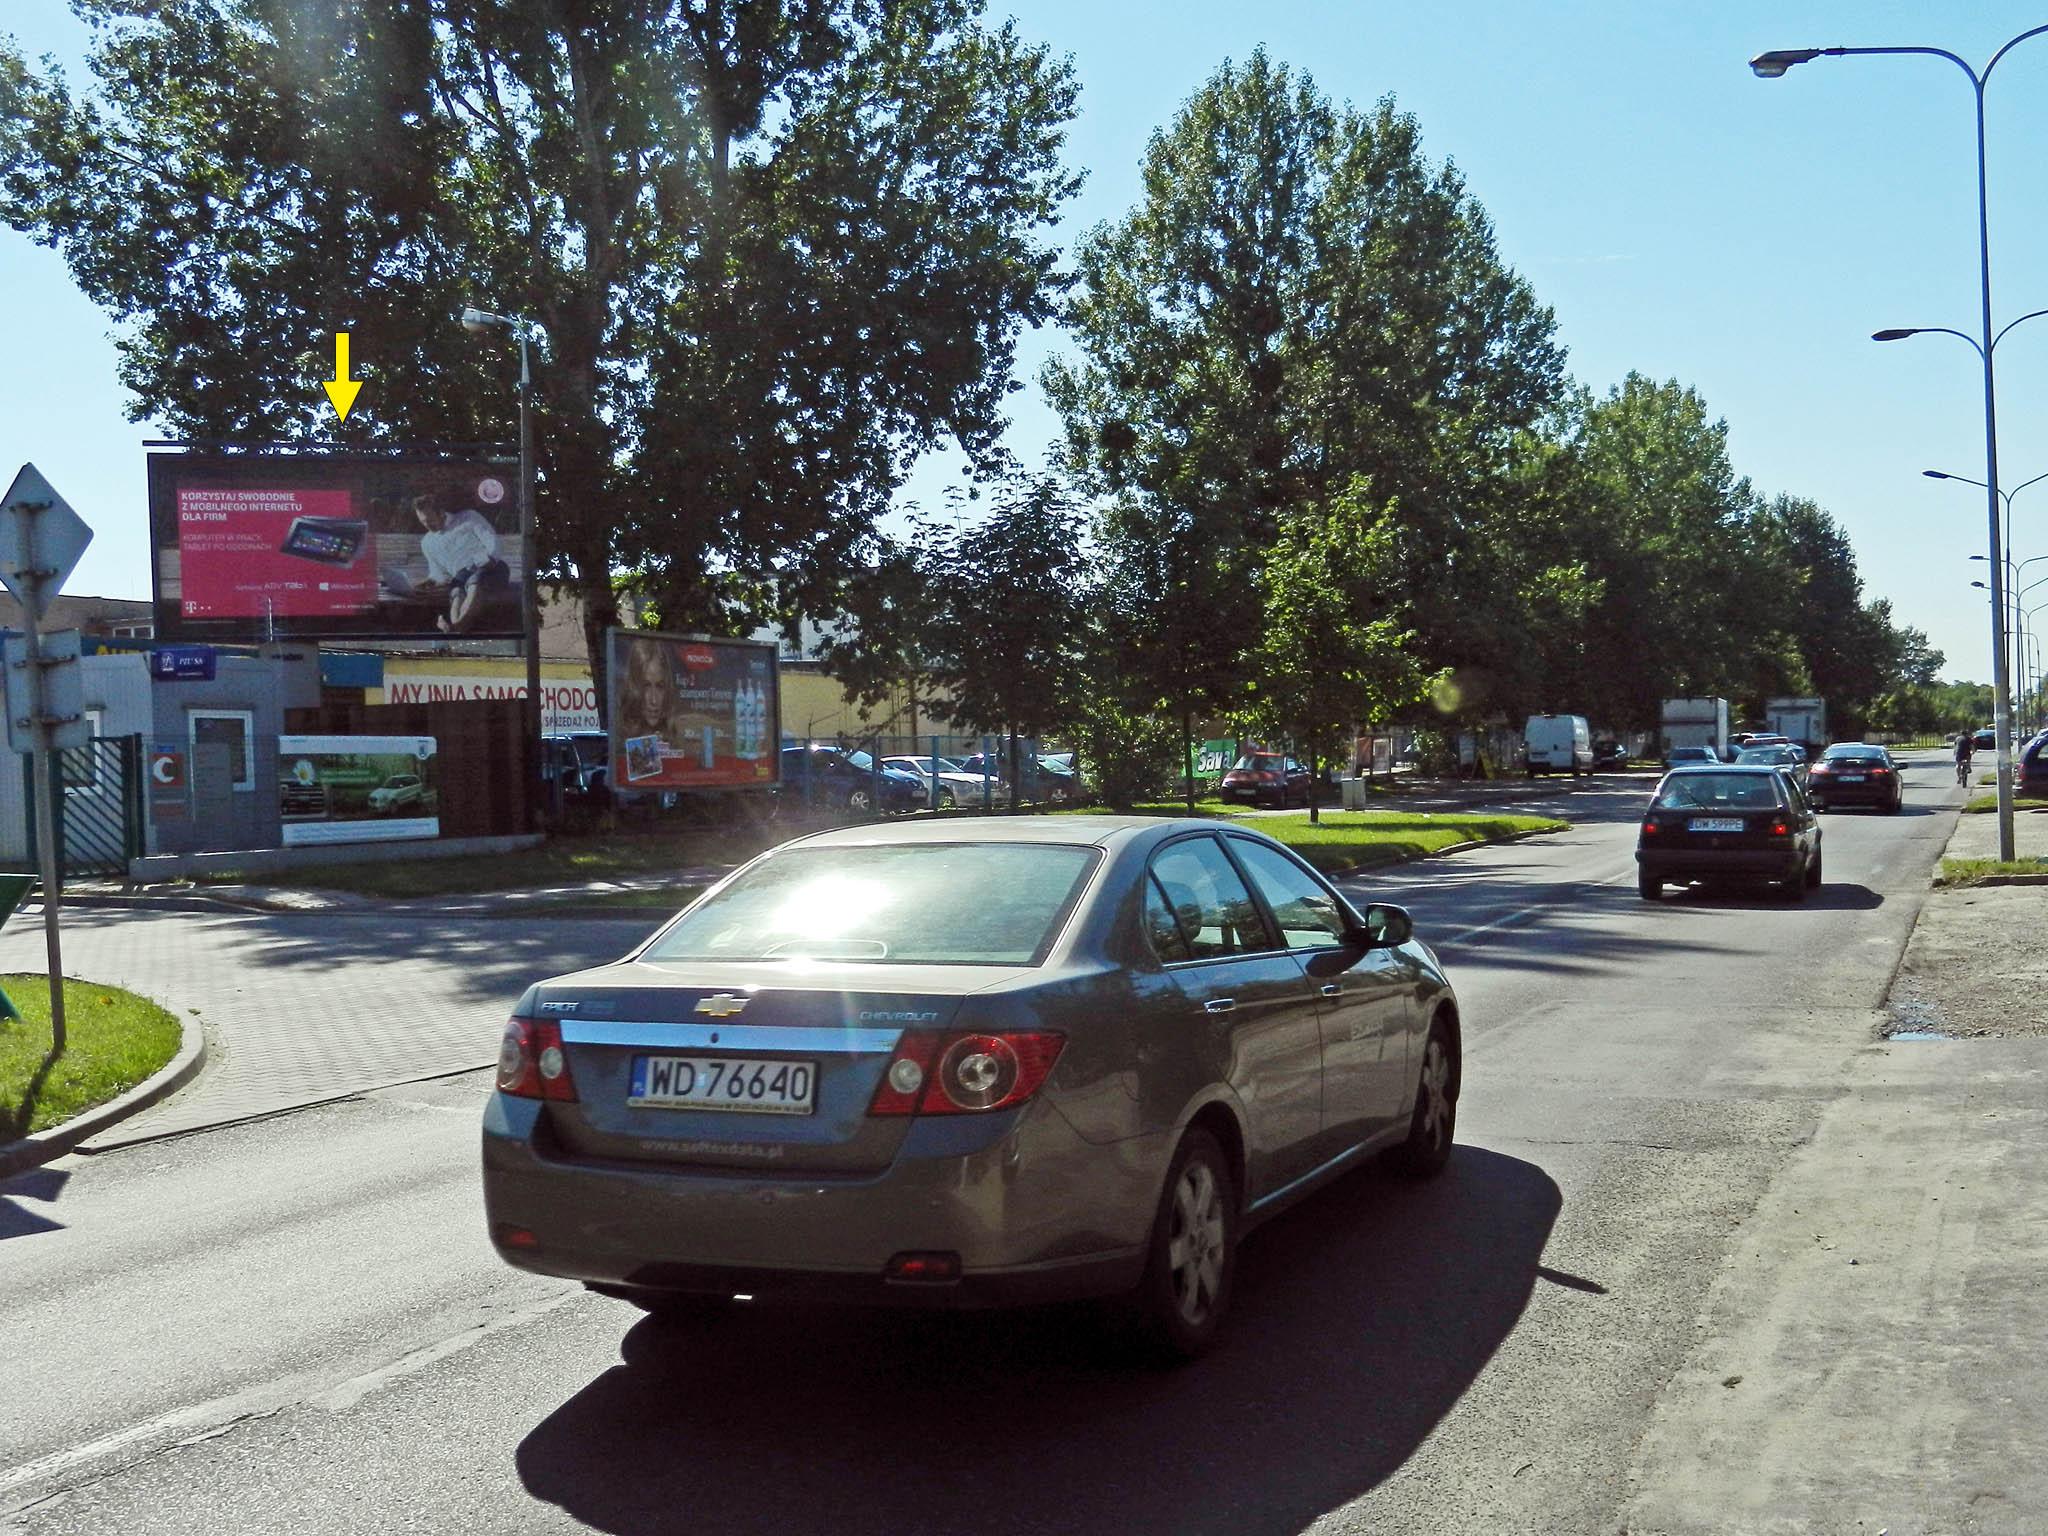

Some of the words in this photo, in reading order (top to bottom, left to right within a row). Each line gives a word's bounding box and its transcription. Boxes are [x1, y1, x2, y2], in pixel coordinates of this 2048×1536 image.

[181, 492, 236, 501] KORZYSTAJ
[238, 492, 296, 501] SWOBODNIE
[182, 503, 188, 511] Z
[190, 503, 248, 512] MOBILNEGO
[249, 503, 303, 512] INTERNETU
[182, 513, 202, 521] DLA
[203, 513, 228, 521] FIRM
[1198, 747, 1231, 772] Sava
[859, 1010, 939, 1022] CHEVROLET
[652, 1060, 696, 1097] WD
[706, 1062, 810, 1101] 76640
